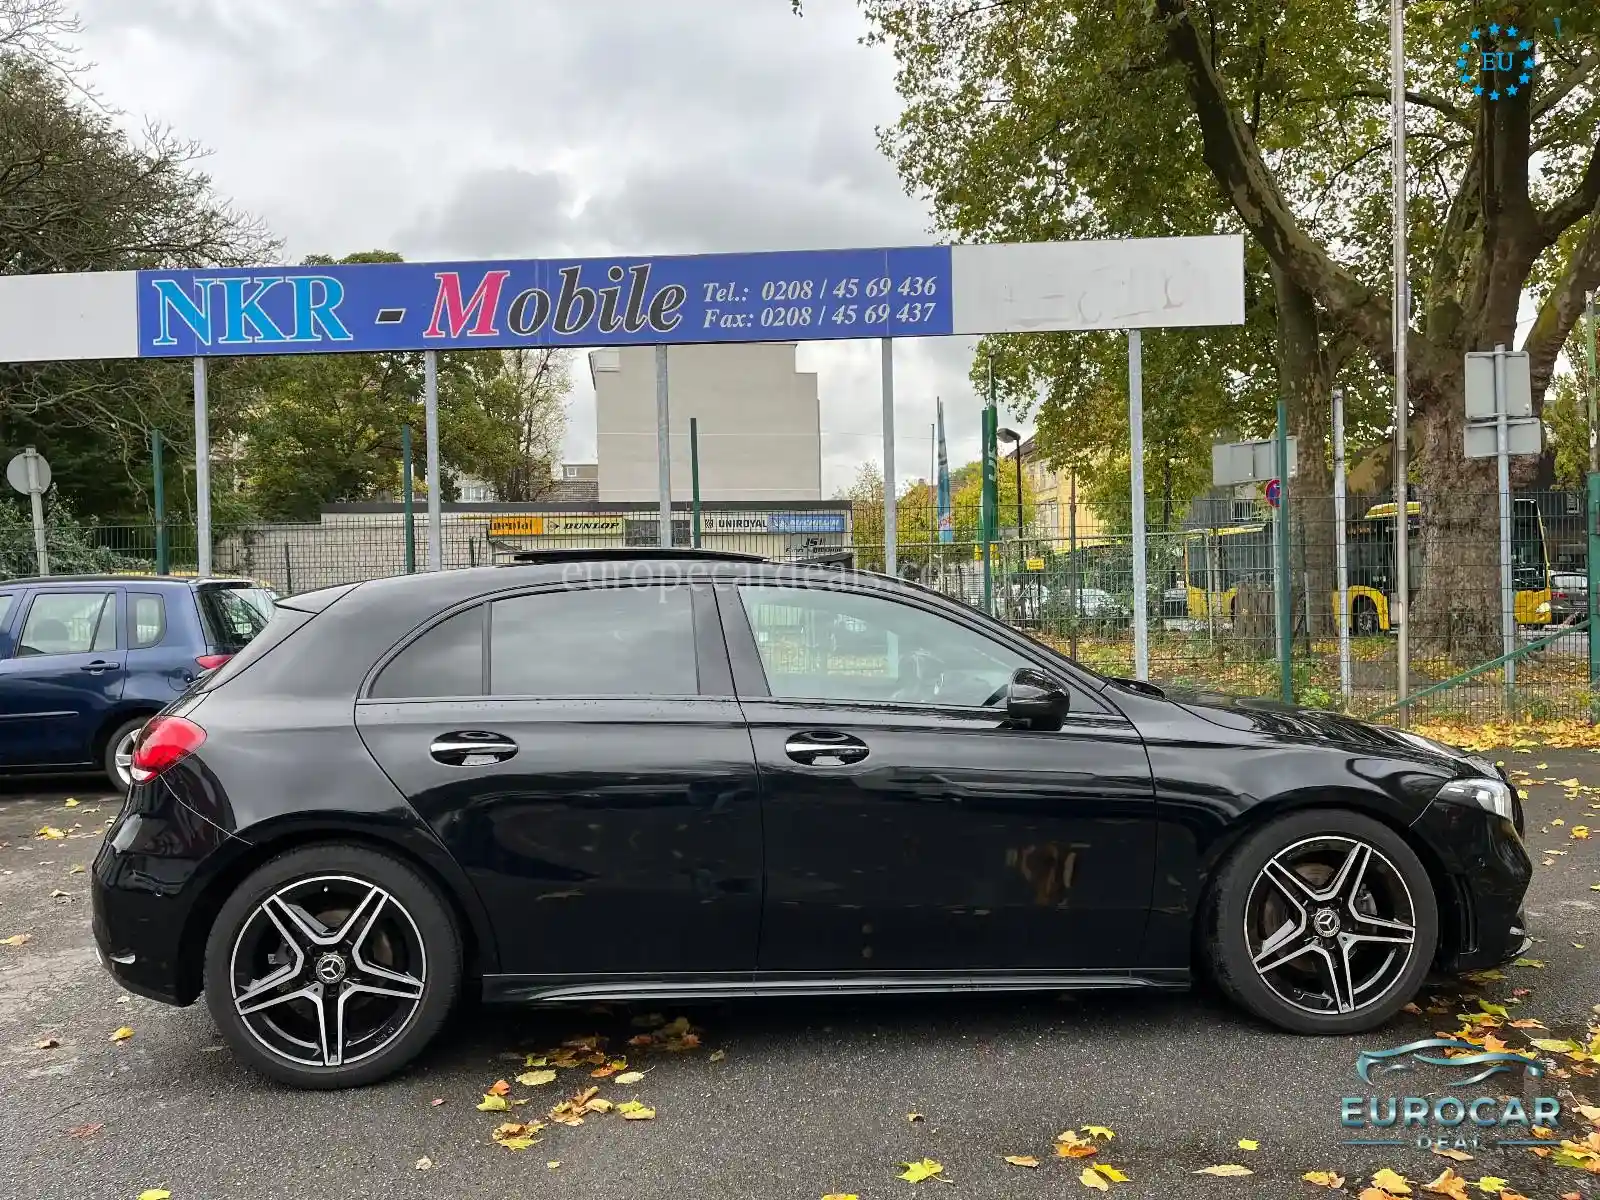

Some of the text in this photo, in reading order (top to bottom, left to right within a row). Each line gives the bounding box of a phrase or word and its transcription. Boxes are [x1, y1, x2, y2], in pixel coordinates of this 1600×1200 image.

[703, 275, 938, 302] Tel.: 0208 / 45 69 436
[152, 263, 687, 346] NKR - Mobile
[703, 302, 937, 328] Fax: 0208 / 45 69 437
[564, 522, 620, 530] DUNLOP
[718, 519, 768, 528] UNIROYAL
